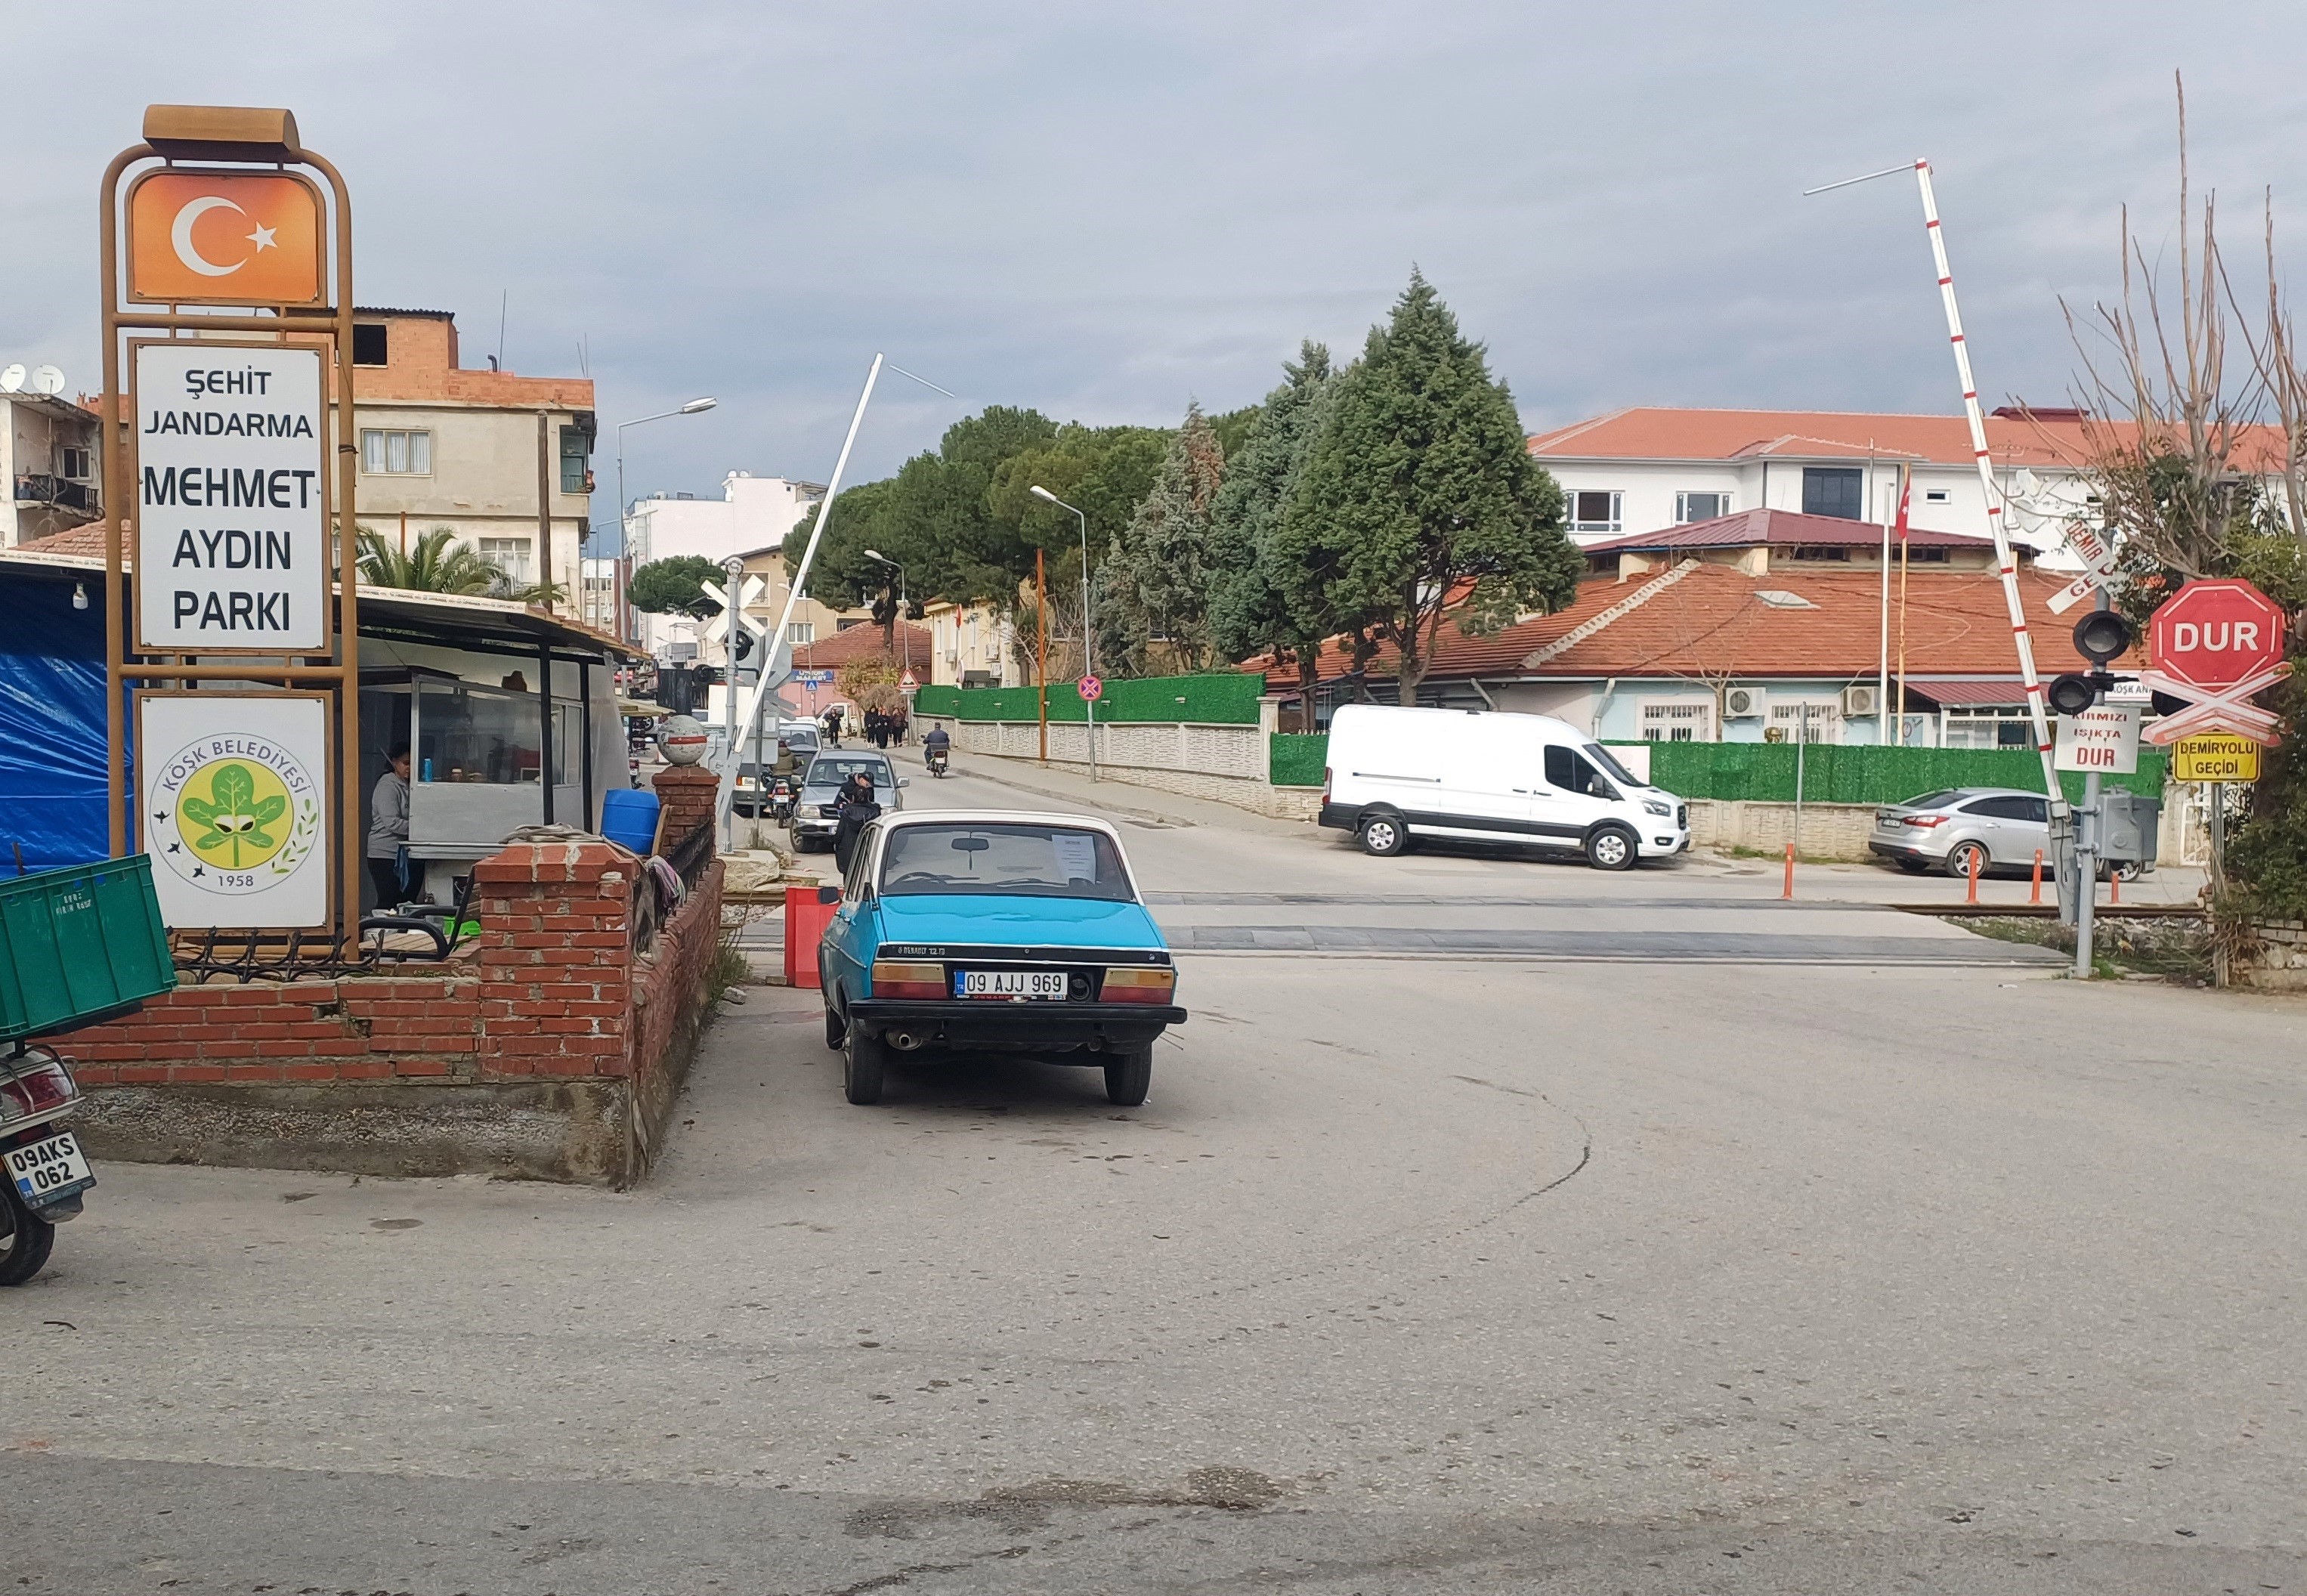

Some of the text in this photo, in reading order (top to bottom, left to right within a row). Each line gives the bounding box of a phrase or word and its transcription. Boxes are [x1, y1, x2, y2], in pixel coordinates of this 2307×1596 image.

[185, 364, 272, 400] ŞEHİT
[144, 410, 314, 438] JANDARMA
[144, 466, 315, 509] MEHMET
[172, 529, 290, 570] AYDIN
[174, 591, 289, 631] PARKI
[2173, 620, 2259, 652] DUR
[2077, 747, 2115, 766] DUR
[2180, 739, 2254, 755] DEMİRYOLU
[162, 739, 311, 795] KÖŞK BELEDİYESİ
[2195, 758, 2238, 776] GEÇİDİ
[218, 875, 254, 887] 1958
[966, 974, 1062, 992] 09 AJJ 969
[11, 1137, 75, 1172] 09AKS
[34, 1161, 74, 1189] 062
